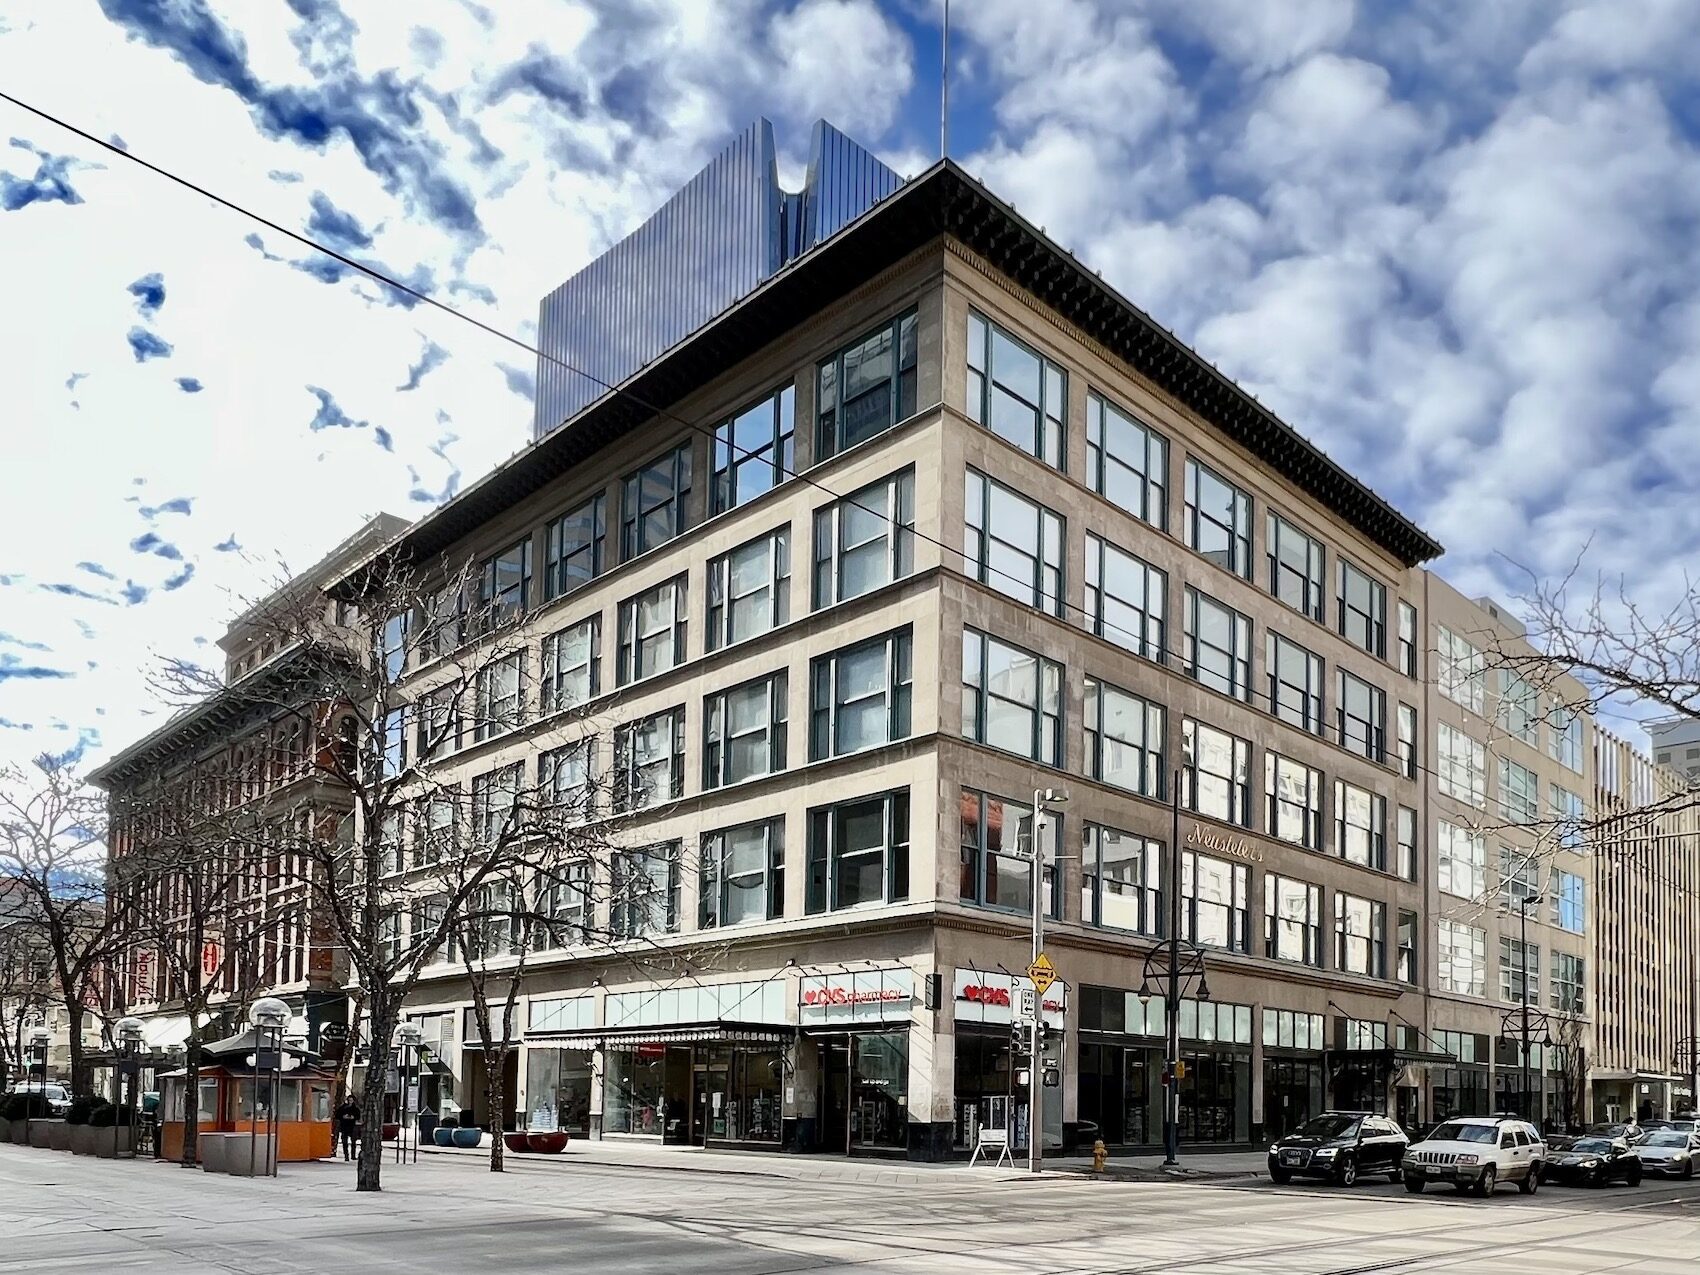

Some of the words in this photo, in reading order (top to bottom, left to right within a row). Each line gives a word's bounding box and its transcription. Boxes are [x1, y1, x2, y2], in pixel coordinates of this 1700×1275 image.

[817, 986, 847, 1005] CVS
[847, 989, 902, 1006] pharmacy
[980, 986, 1010, 1007] CVS
